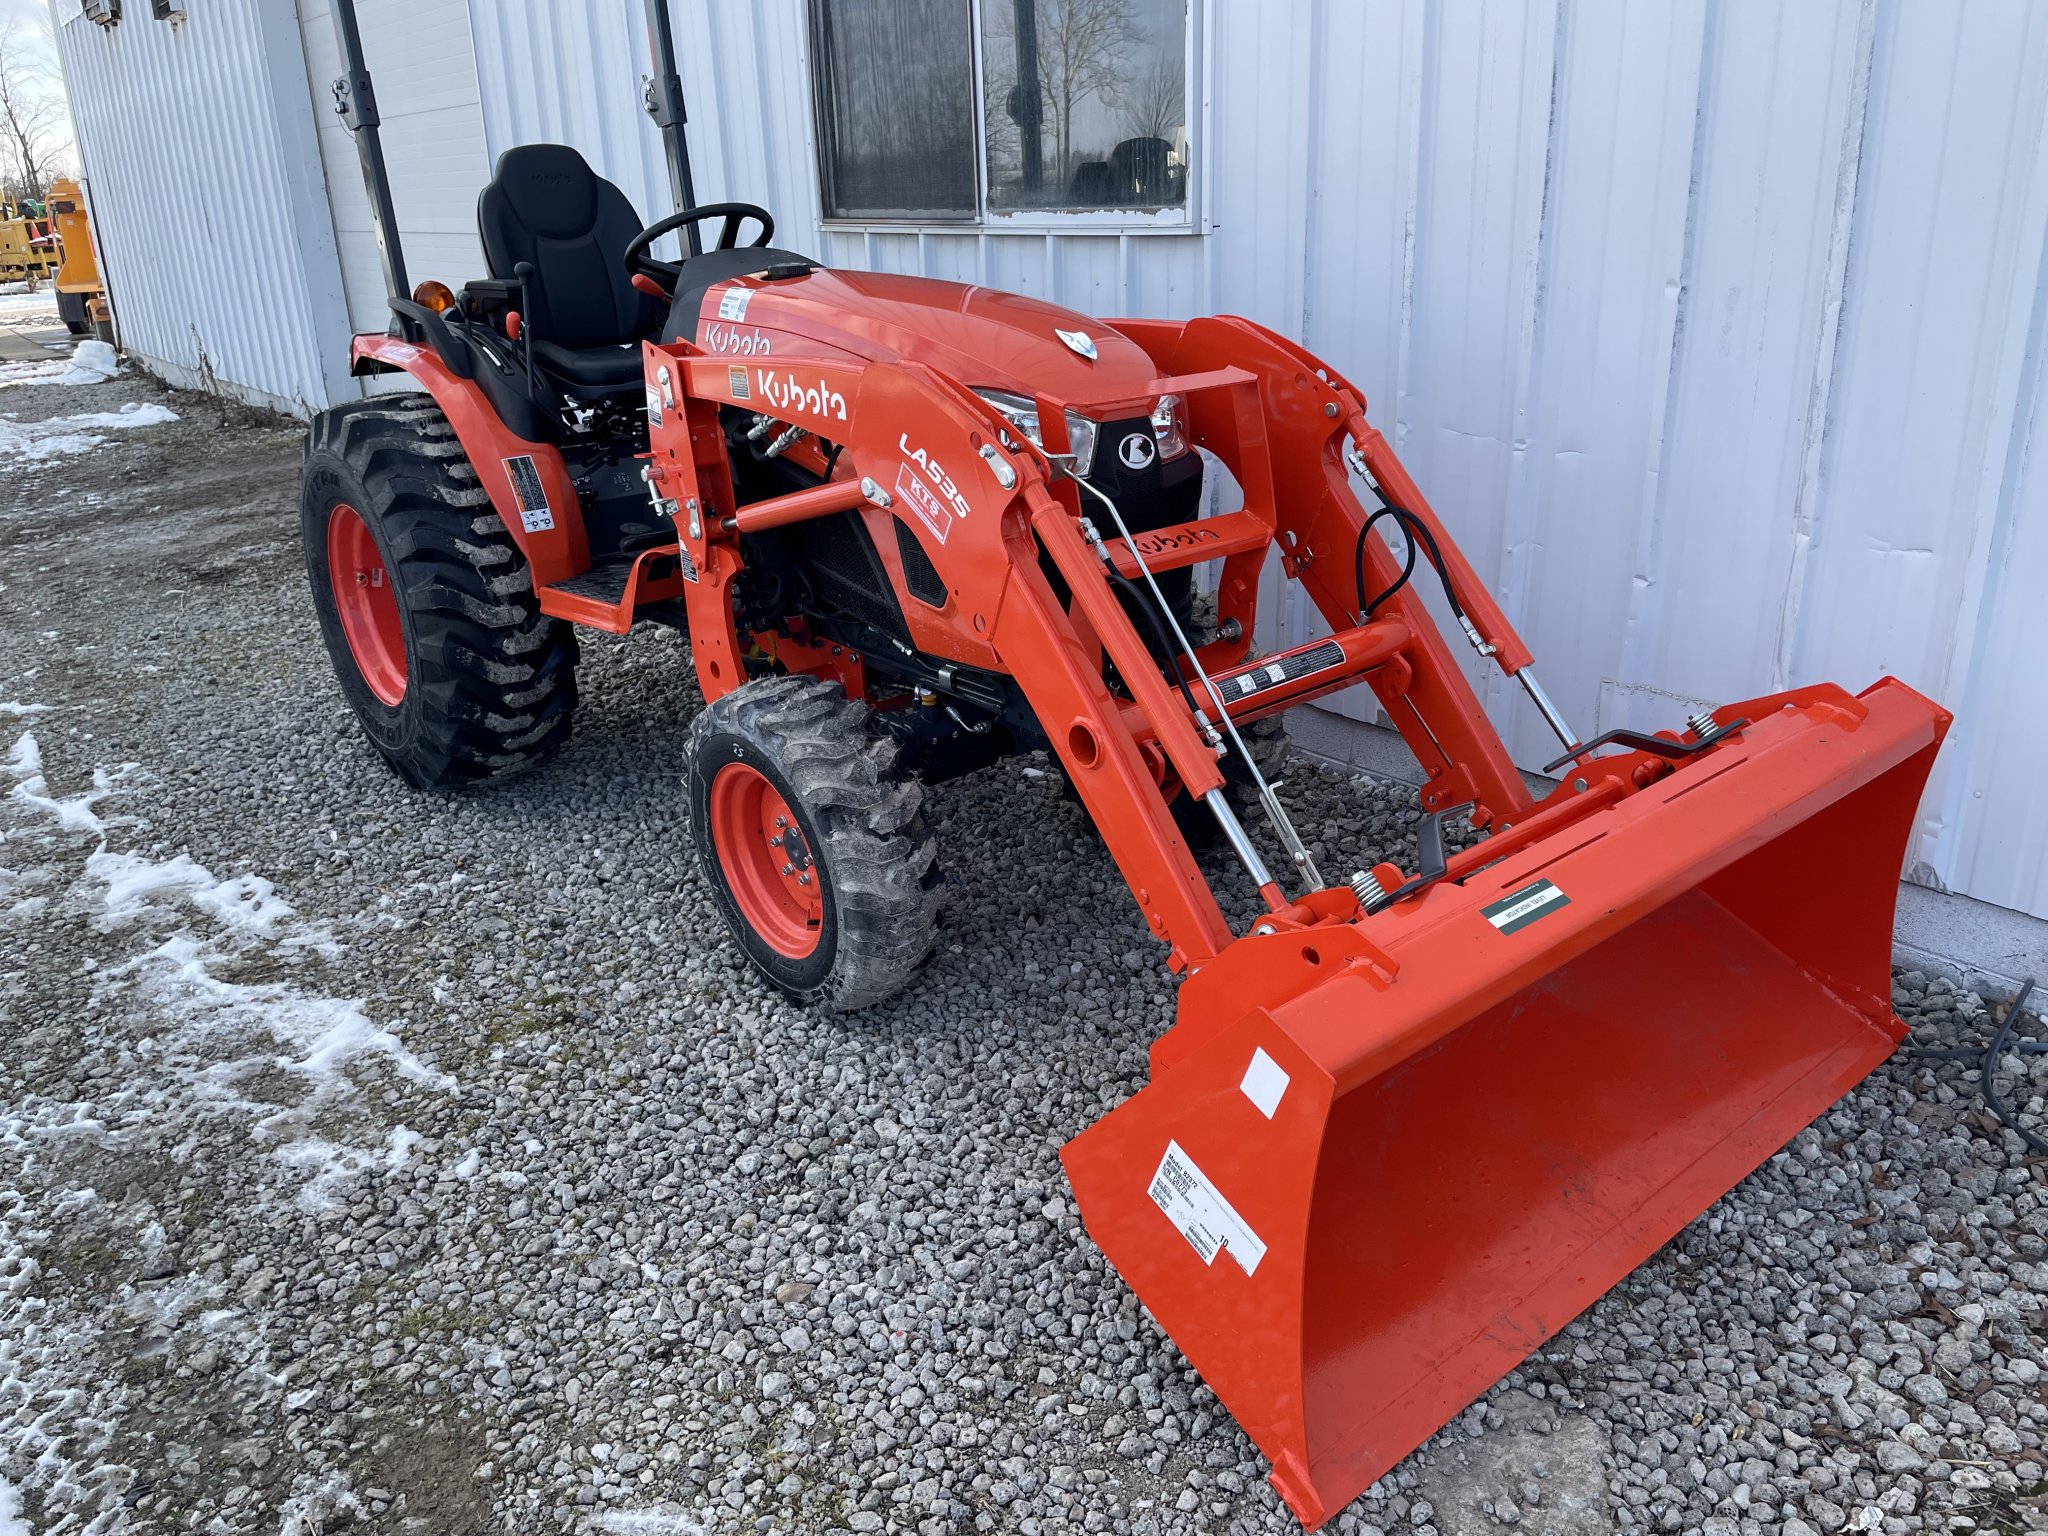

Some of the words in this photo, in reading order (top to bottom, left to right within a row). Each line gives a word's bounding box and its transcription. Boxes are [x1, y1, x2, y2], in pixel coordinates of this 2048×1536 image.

[705, 323, 771, 355] Kubota
[758, 369, 847, 420] Kubota
[900, 432, 971, 519] LA535
[911, 477, 940, 515] KTS
[1120, 528, 1219, 554] Kubota
[1505, 902, 1532, 918] INDICATOR
[1530, 894, 1547, 905] LEVEL
[1168, 1153, 1183, 1171] Model
[1219, 1234, 1229, 1248] 10
